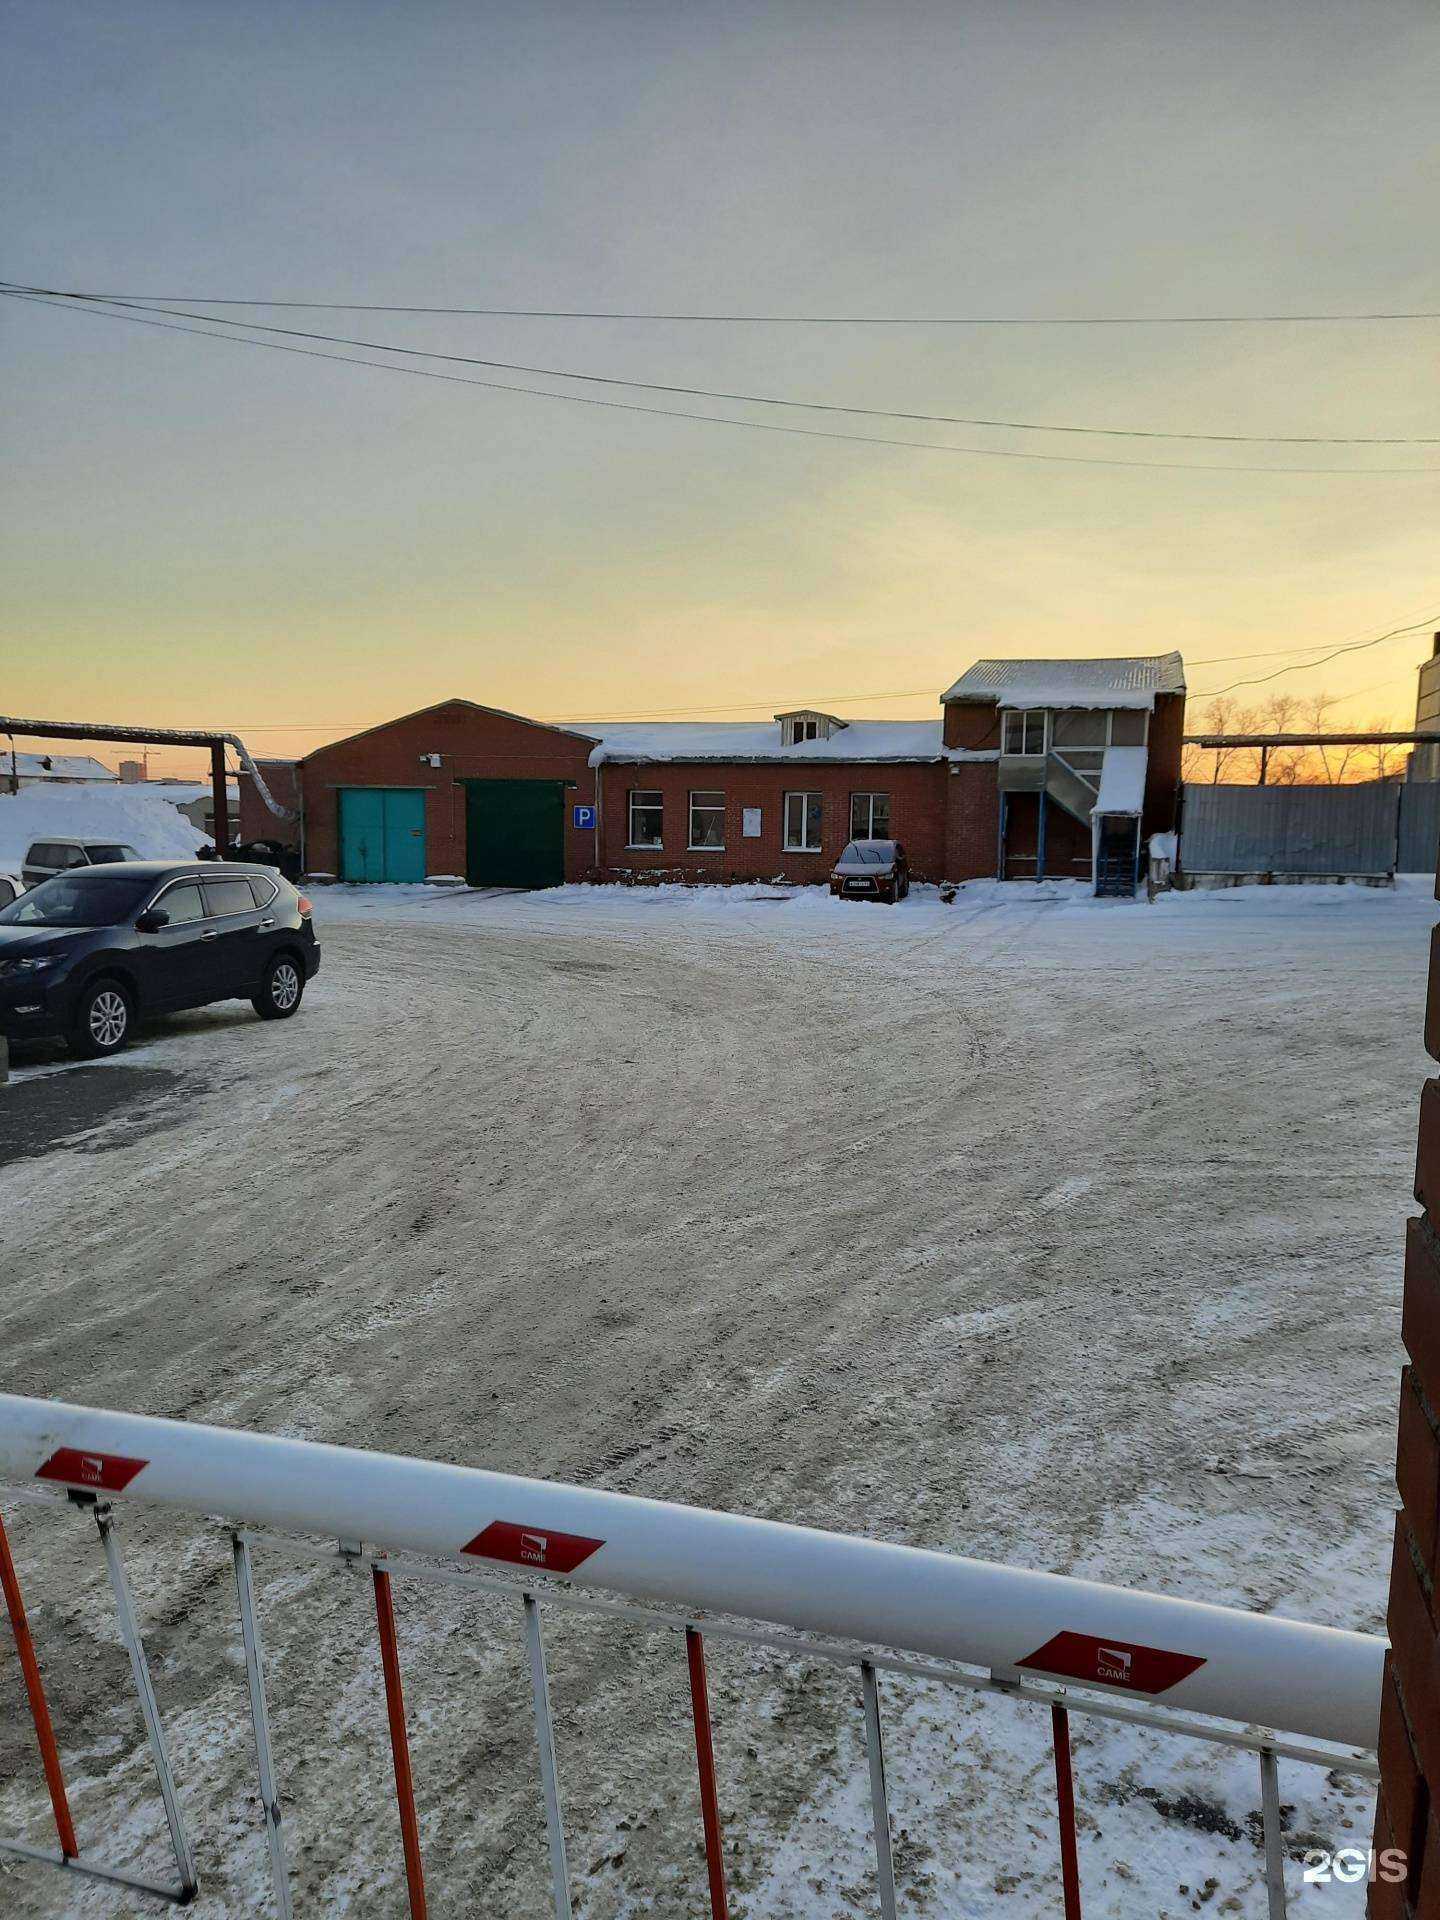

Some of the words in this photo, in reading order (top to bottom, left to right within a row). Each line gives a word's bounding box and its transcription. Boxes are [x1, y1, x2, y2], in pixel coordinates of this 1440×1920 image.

[579, 808, 590, 825] P
[520, 1550, 545, 1562] CAME
[1097, 1667, 1131, 1681] CAME
